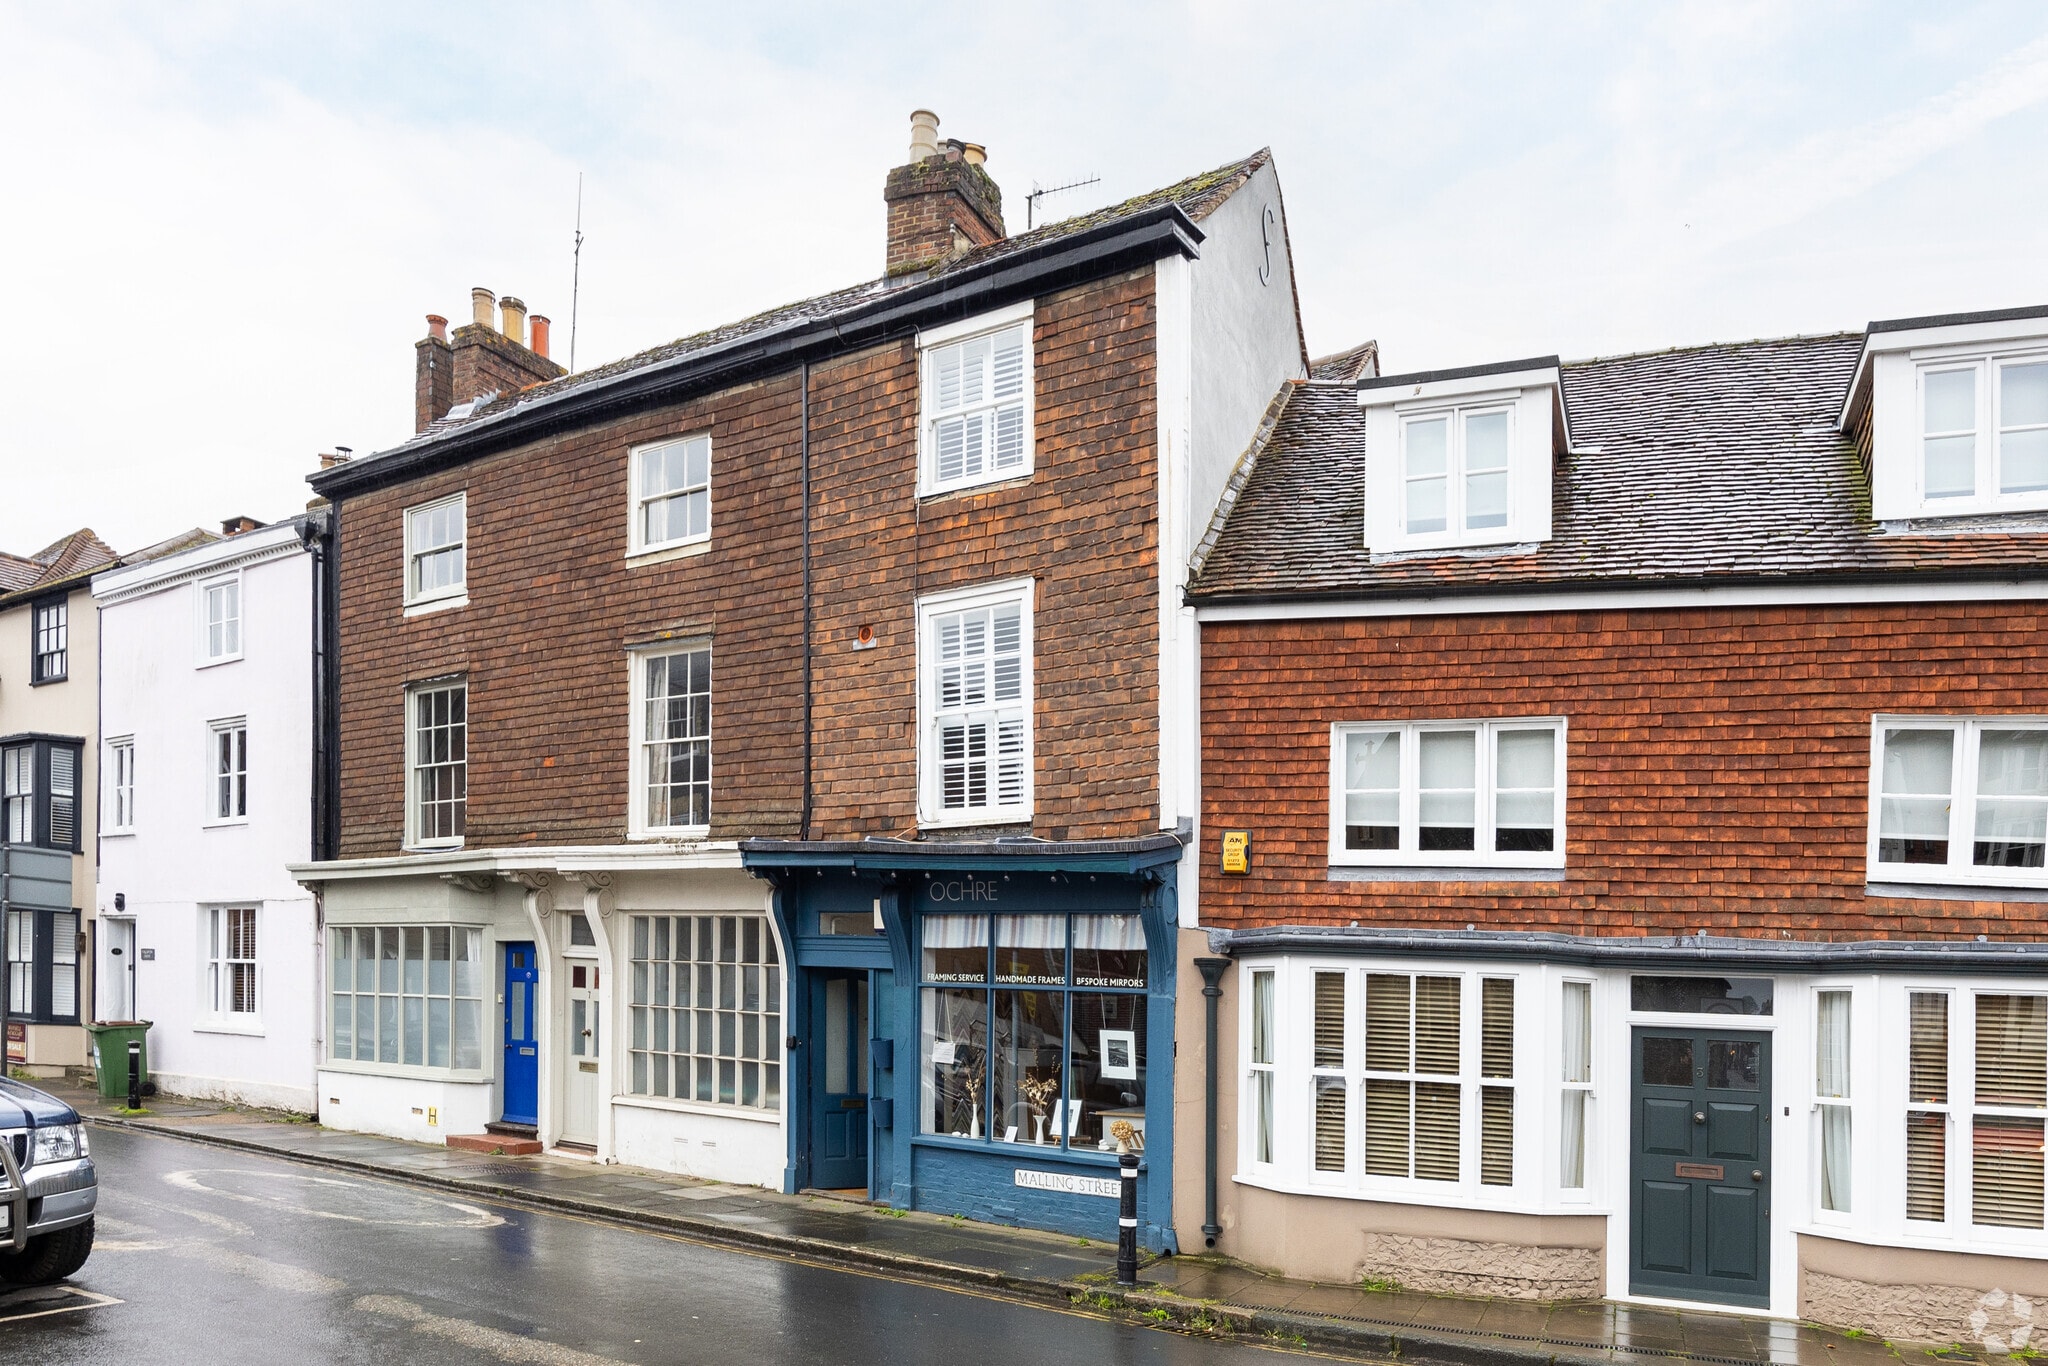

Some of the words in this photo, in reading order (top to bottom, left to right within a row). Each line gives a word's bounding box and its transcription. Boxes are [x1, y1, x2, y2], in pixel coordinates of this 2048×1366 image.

[930, 881, 998, 901] OCHRE
[927, 973, 957, 981] FRAMING
[958, 973, 985, 982] SERVICE
[995, 974, 1037, 984] HANDMADE
[1037, 975, 1066, 985] FRAMES
[587, 990, 591, 999] 7
[428, 1107, 437, 1124] H
[1017, 1172, 1075, 1191] MALLING
[1079, 1178, 1121, 1195] STREE
